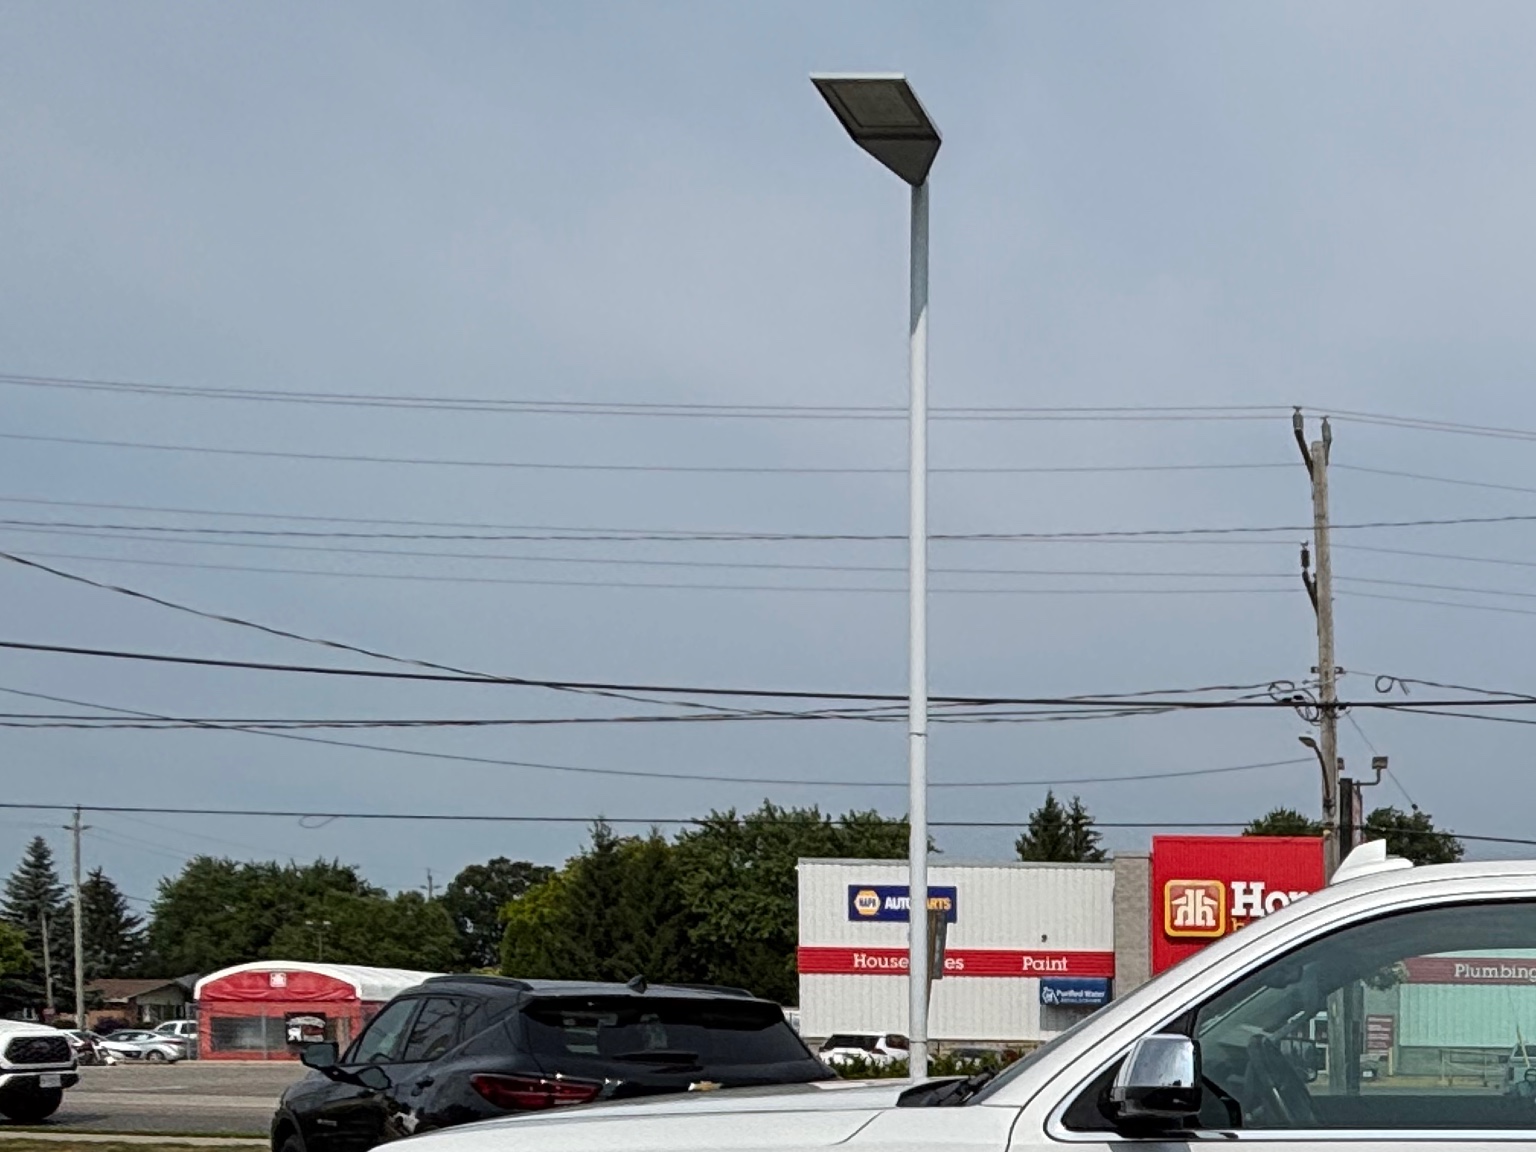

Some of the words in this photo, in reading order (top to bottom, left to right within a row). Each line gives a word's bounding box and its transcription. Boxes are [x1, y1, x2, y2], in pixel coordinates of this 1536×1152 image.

[926, 897, 952, 911] ARTS
[853, 953, 965, 971] Housees
[1022, 956, 1068, 971] Paint
